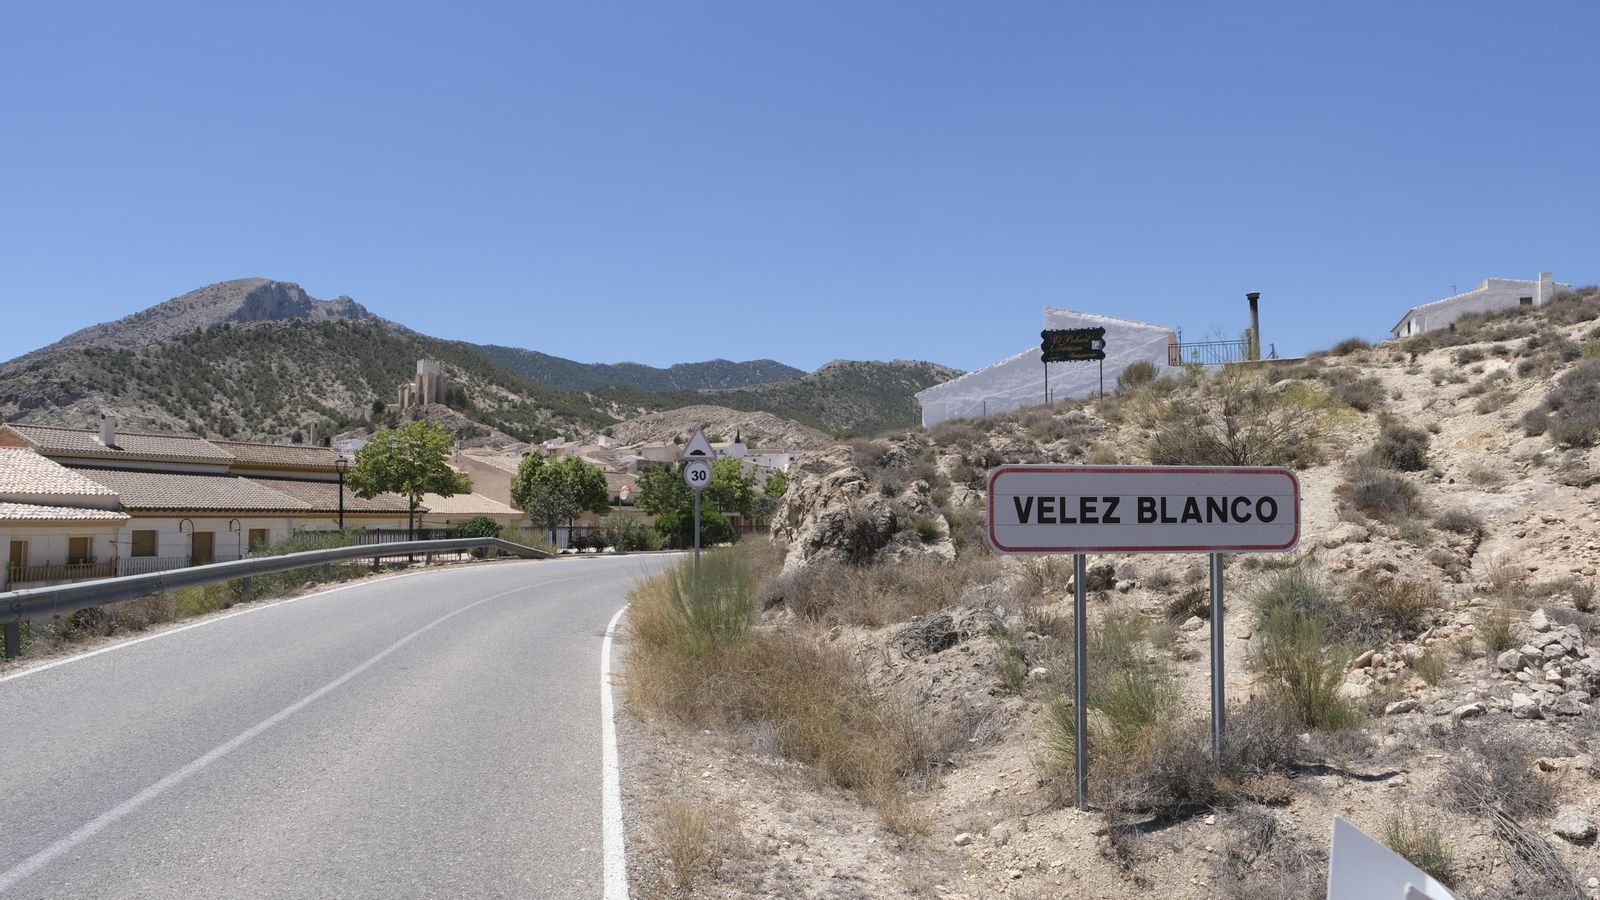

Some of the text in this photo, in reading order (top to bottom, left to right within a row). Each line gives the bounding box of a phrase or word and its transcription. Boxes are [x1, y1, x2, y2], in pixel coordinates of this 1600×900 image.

[691, 470, 706, 481] 30
[1012, 496, 1279, 524] VELEZ BLANCO
